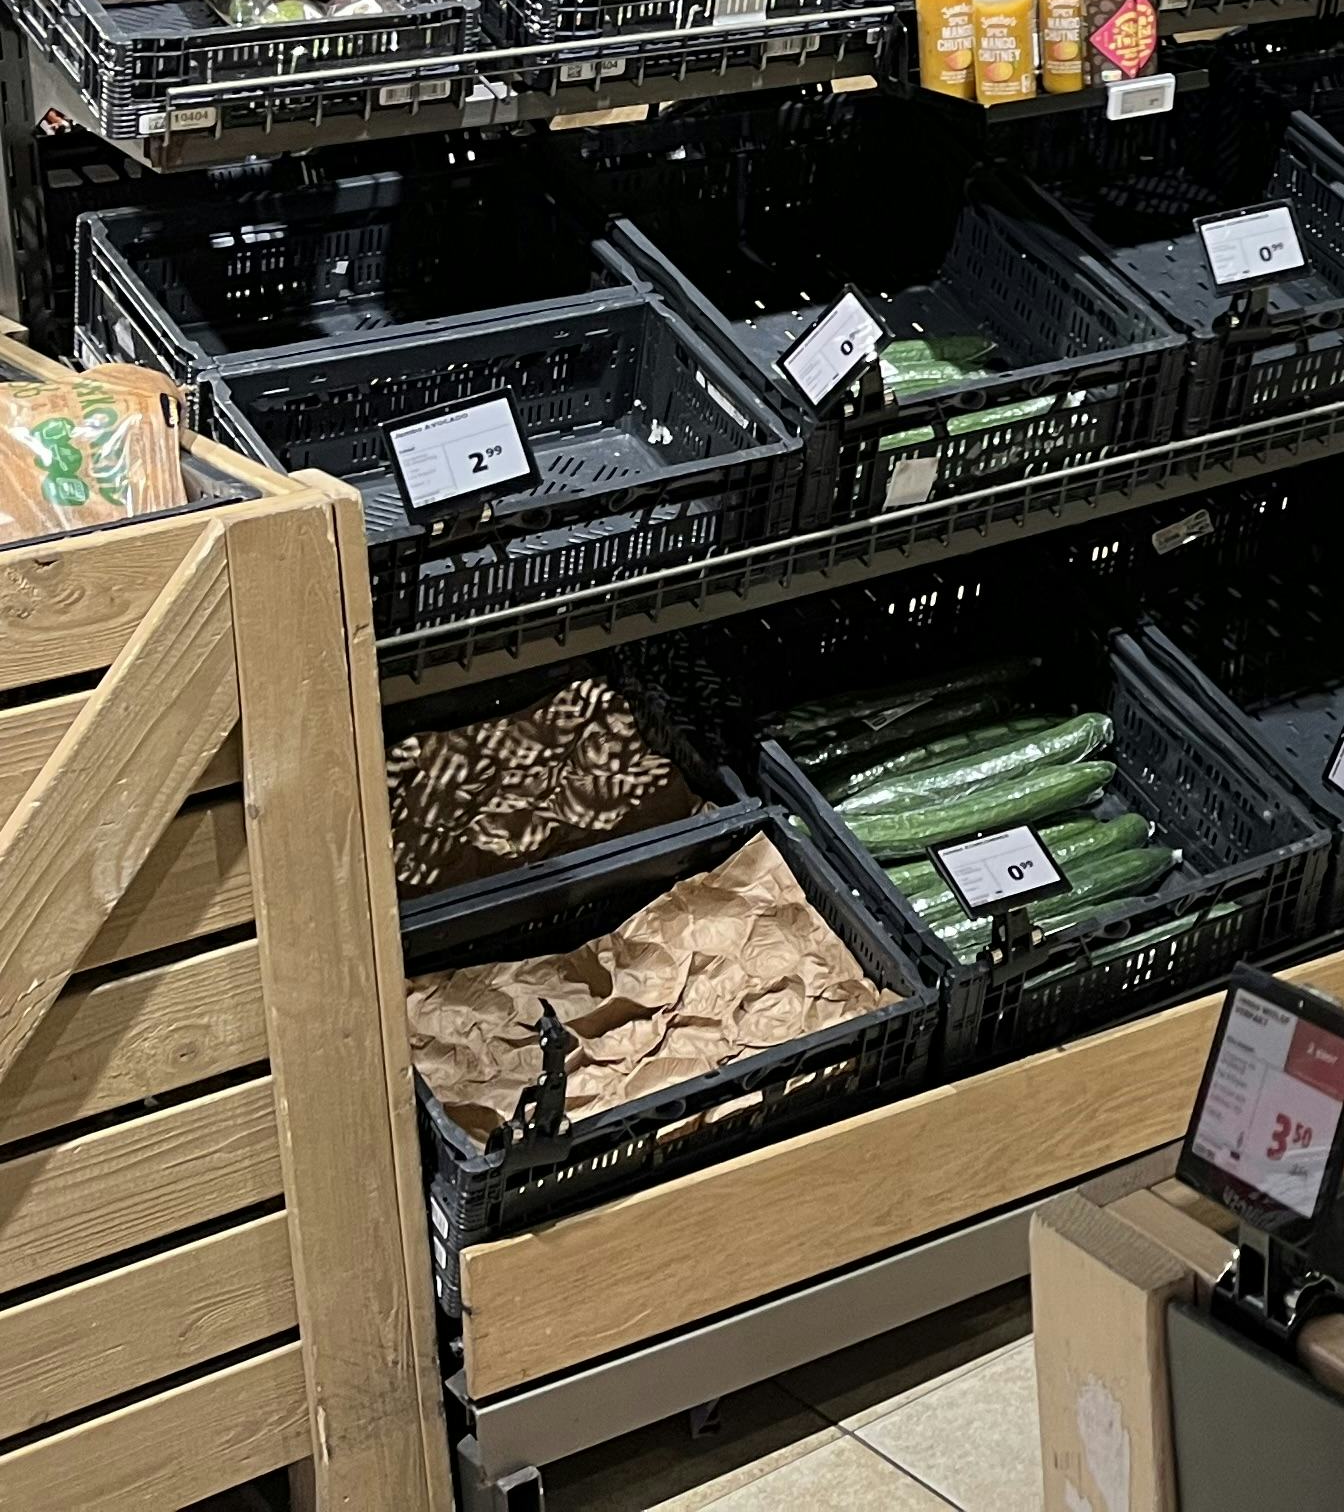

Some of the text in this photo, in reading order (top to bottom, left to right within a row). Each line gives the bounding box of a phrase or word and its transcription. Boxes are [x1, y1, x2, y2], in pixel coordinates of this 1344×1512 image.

[941, 25, 973, 39] MANG
[1045, 29, 1080, 42] CHUTNE
[981, 37, 1016, 49] MANGO
[978, 49, 1021, 62] CHUTNEY
[425, 413, 468, 429] AVOCADO
